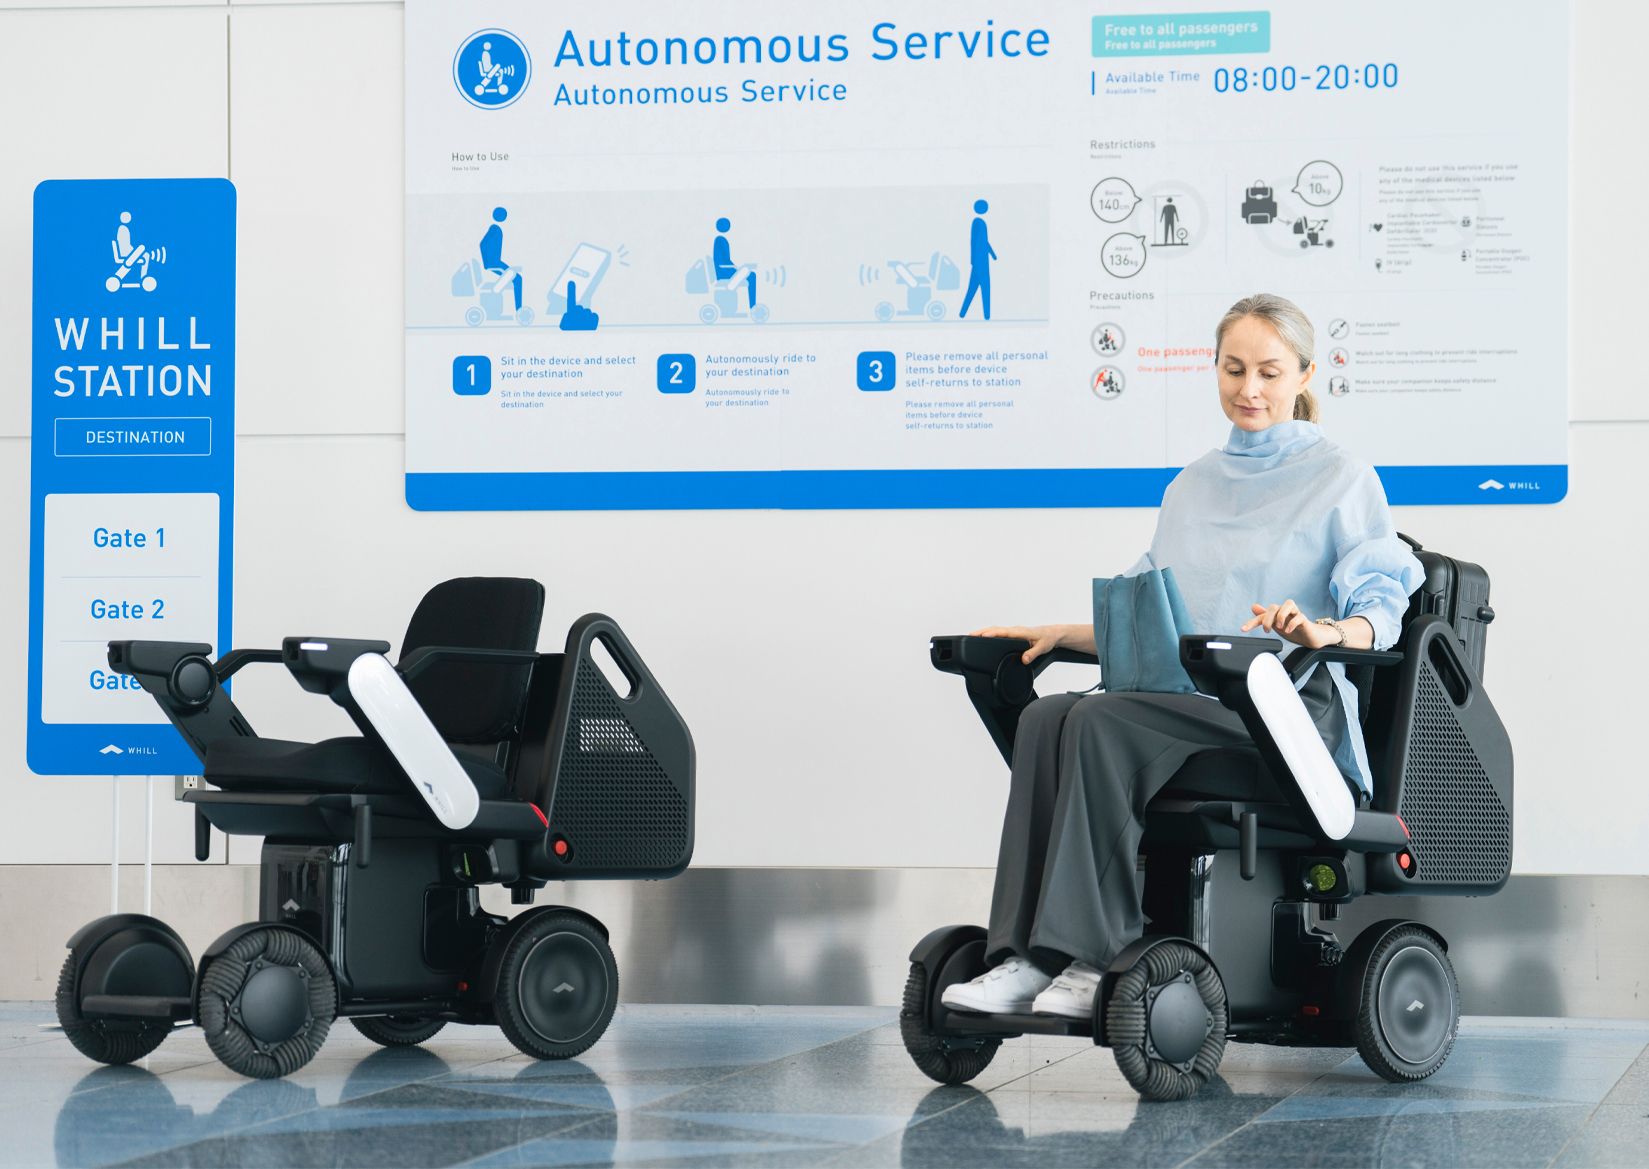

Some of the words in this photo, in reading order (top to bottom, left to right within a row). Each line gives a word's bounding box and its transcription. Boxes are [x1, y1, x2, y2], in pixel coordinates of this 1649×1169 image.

[1105, 23, 1136, 37] Free
[1140, 23, 1153, 36] to
[1157, 22, 1175, 36] all
[1179, 21, 1258, 36] passengers
[554, 30, 848, 67] Autonomous
[872, 20, 1049, 60] Service
[1105, 40, 1129, 50] Free
[1130, 40, 1142, 50] to
[1143, 39, 1157, 49] all
[1158, 38, 1217, 50] passengers
[1105, 71, 1164, 83] Available
[1169, 70, 1200, 81] Time
[1215, 63, 1398, 93] 08:00-20:00
[554, 83, 728, 106] Autonomous
[742, 79, 846, 102] Service
[1090, 139, 1155, 149] Restrictions
[452, 152, 473, 161] How
[477, 152, 486, 160] to
[491, 151, 508, 160] Use
[1090, 290, 1154, 300] Precautions
[55, 317, 210, 350] WHILL
[906, 351, 940, 361] Please
[986, 351, 998, 360] all
[1002, 351, 1048, 362] personal
[1137, 347, 1160, 357] One
[501, 356, 514, 365] Sit
[518, 356, 526, 365] in
[530, 356, 545, 365] the
[549, 356, 580, 365] device
[584, 355, 602, 365] and
[605, 355, 635, 364] select
[706, 353, 778, 365] Autonomously
[783, 353, 803, 362] ride
[807, 354, 816, 362] to
[467, 364, 475, 385] 1
[501, 371, 523, 380] your
[527, 369, 582, 378] destination
[670, 362, 682, 384] 2
[706, 369, 728, 378] your
[732, 367, 789, 376] destination
[869, 360, 883, 382] 3
[906, 365, 934, 374] items
[938, 364, 971, 374] before
[975, 364, 1007, 373] device
[54, 365, 211, 397] STATION
[906, 378, 968, 387] self-returns
[973, 378, 982, 386] to
[986, 377, 1020, 386] station
[537, 389, 562, 397] device
[564, 389, 578, 397] and
[580, 389, 603, 397] select
[705, 388, 761, 397] Autonomously
[501, 400, 543, 408] destination
[906, 400, 932, 408] Please
[934, 400, 964, 408] remove
[966, 399, 976, 407] all
[979, 399, 1013, 408] personal
[906, 410, 927, 418] items
[930, 409, 955, 418] before
[958, 410, 983, 418] device
[906, 421, 954, 429] self-returns
[966, 421, 993, 429] station
[87, 431, 184, 443] DESTINATION
[1509, 481, 1539, 489] WHILL
[94, 528, 146, 547] Gate
[157, 528, 163, 547] 1
[91, 599, 143, 619] Gate
[152, 599, 164, 619] 2
[90, 670, 141, 690] Gate
[128, 746, 157, 754] WHILL
